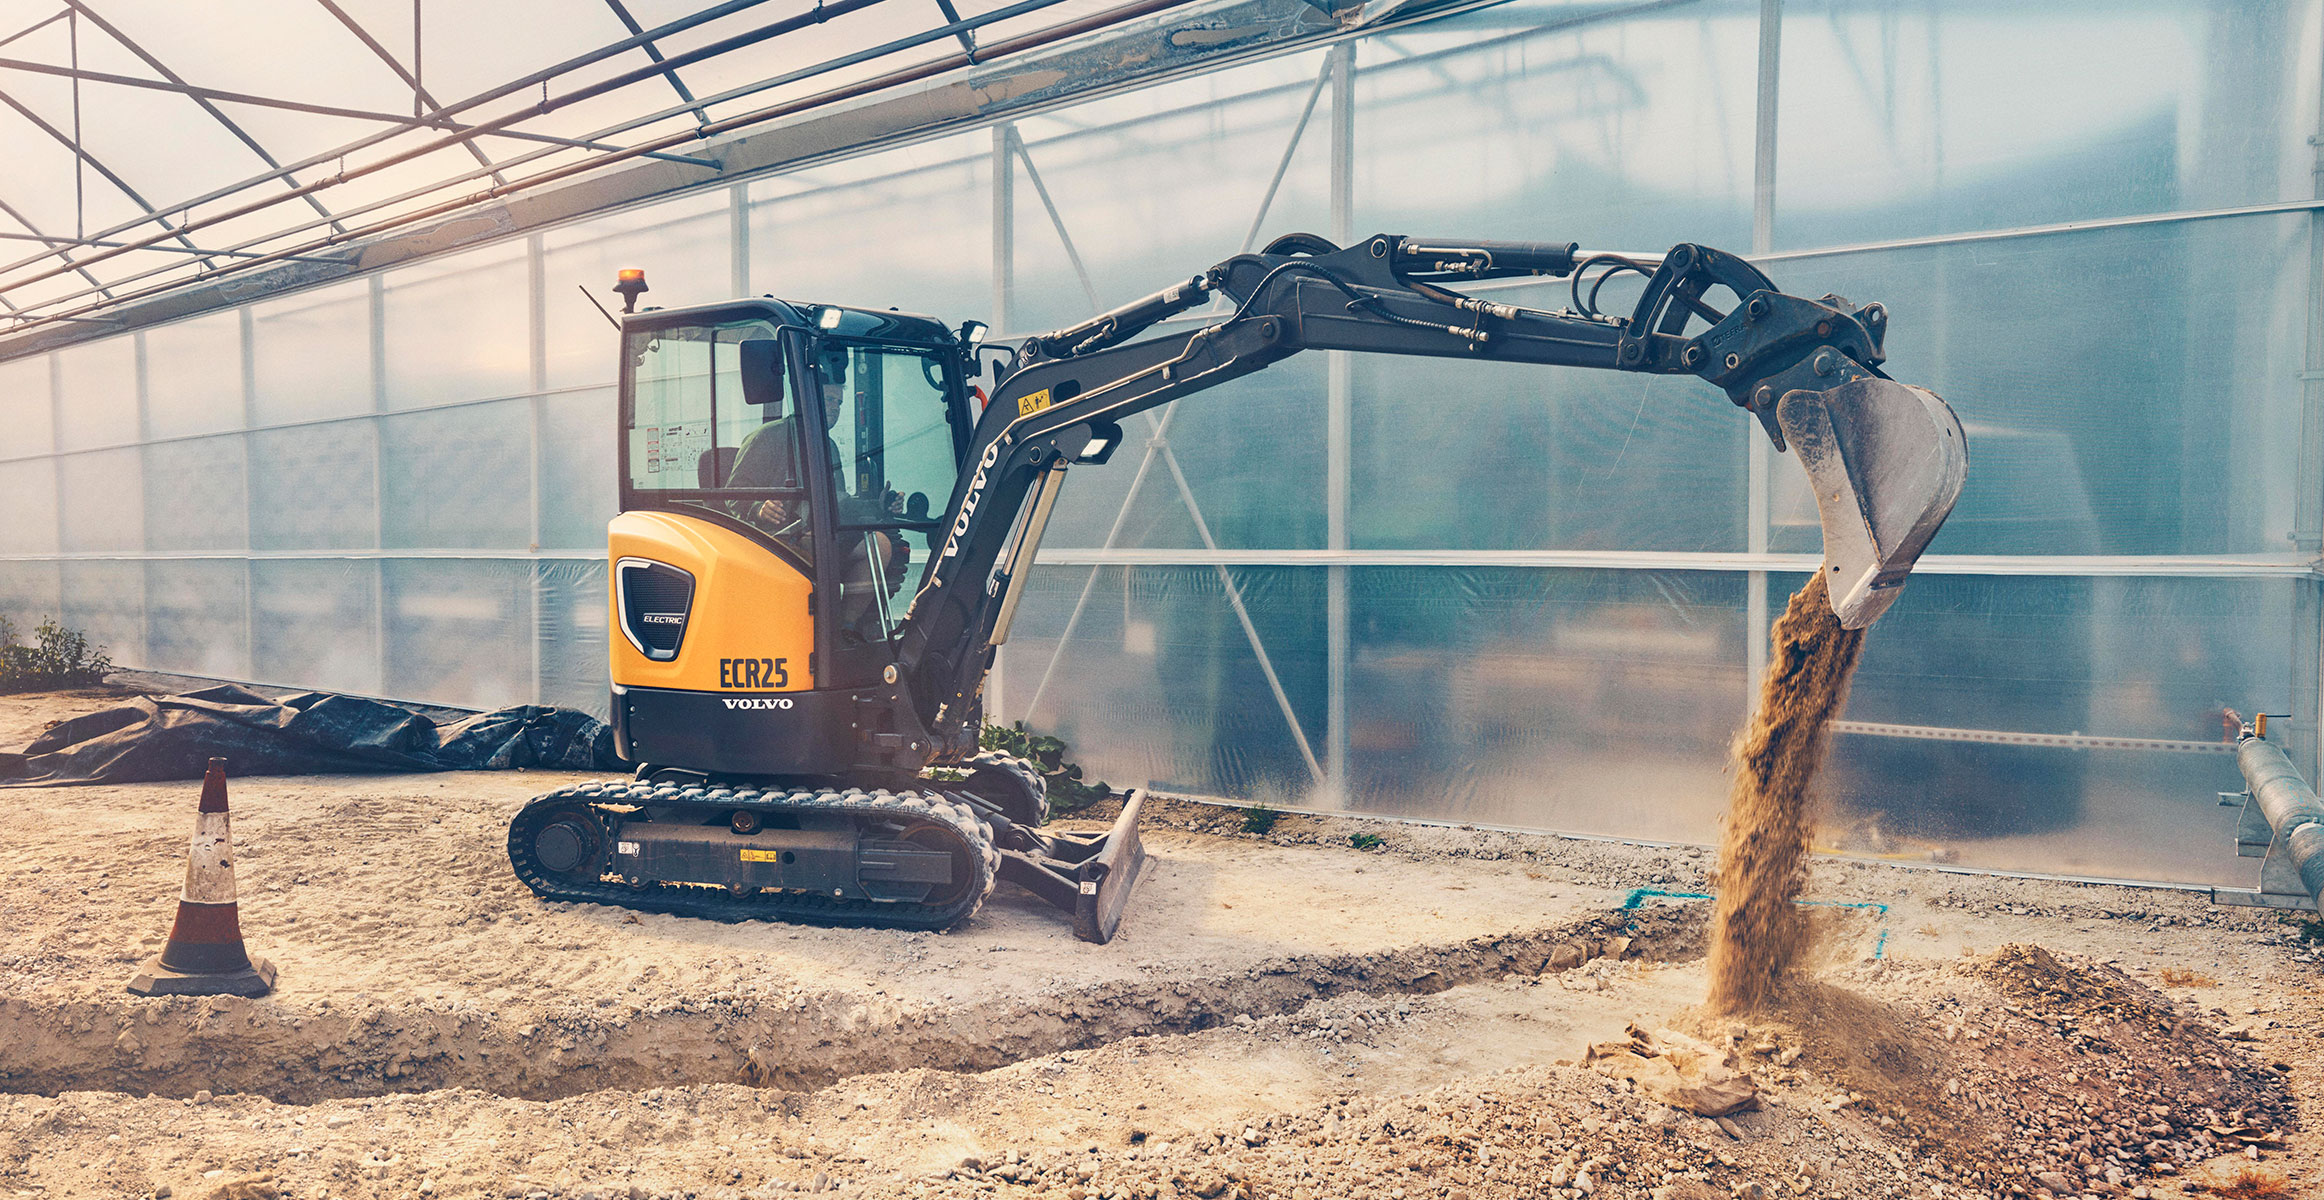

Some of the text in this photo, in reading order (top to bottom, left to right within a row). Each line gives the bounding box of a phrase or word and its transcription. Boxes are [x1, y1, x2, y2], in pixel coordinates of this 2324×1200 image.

[944, 443, 998, 557] VOLVO
[643, 615, 683, 625] ELECTRIC
[720, 658, 788, 688] ECR25
[722, 698, 793, 710] VOLVO
